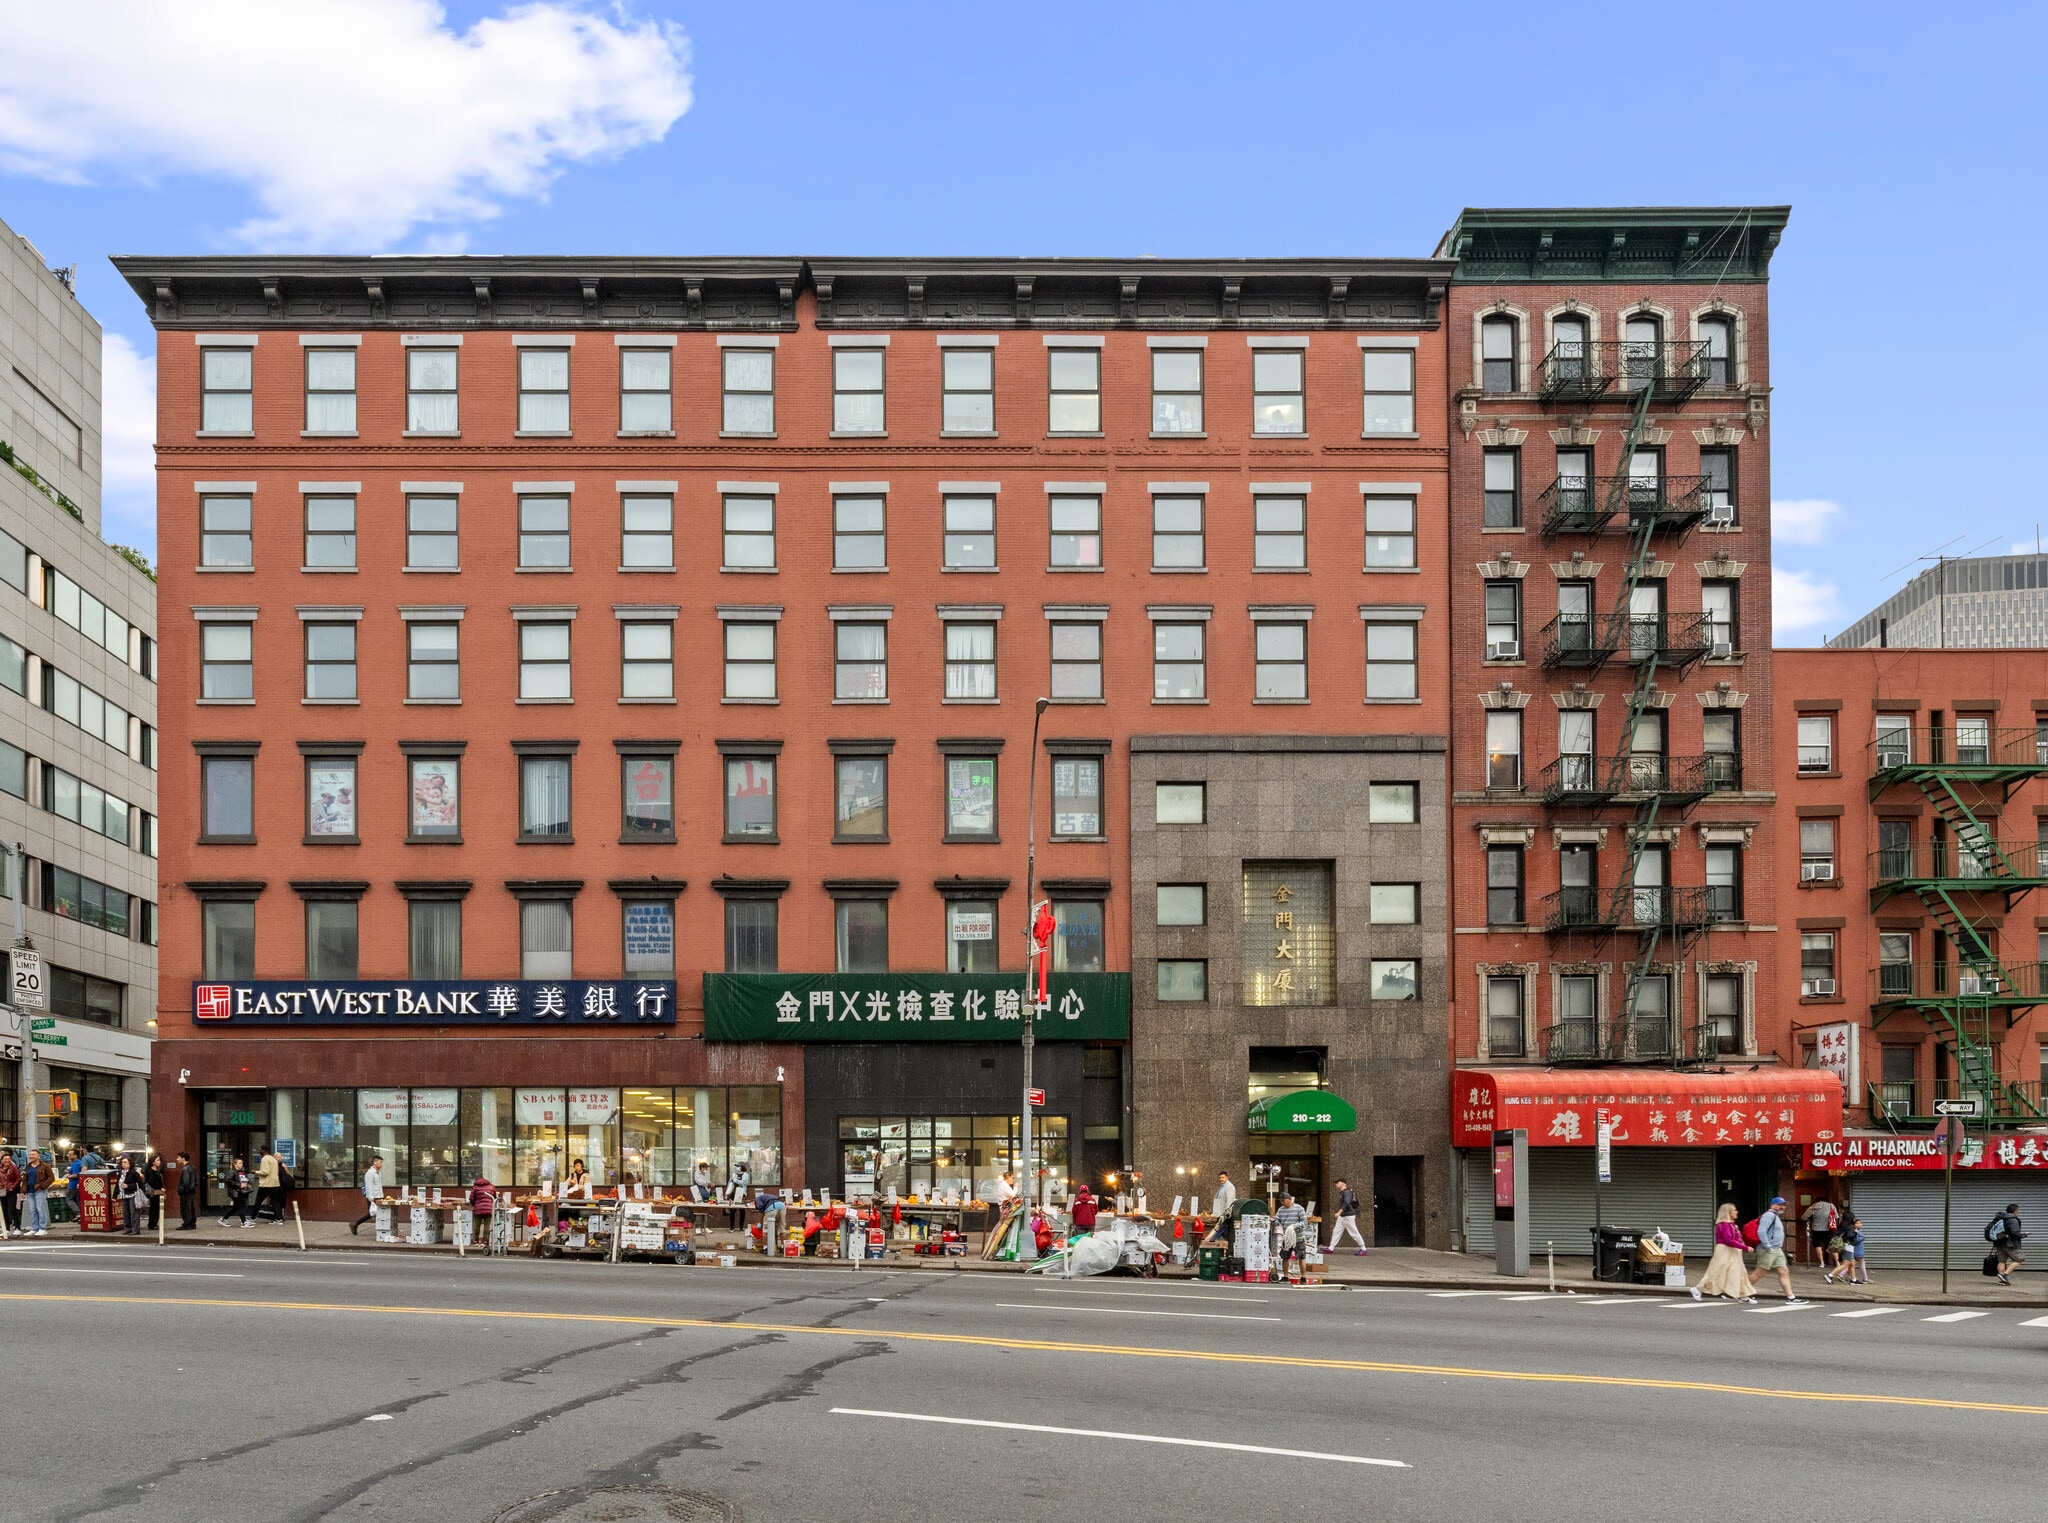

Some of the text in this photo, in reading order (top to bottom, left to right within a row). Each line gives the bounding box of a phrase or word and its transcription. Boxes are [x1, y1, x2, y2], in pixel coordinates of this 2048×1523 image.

[736, 762, 768, 800] 山
[1059, 813, 1096, 833] 古董
[979, 923, 991, 932] RENT
[12, 950, 39, 962] SPEED
[16, 960, 36, 971] LIMIT
[15, 972, 40, 990] 20
[16, 997, 42, 1006] ENFORCED
[394, 988, 482, 1015] BANK
[486, 984, 669, 1019] 華美銀行
[32, 1019, 50, 1027] CANAL
[1520, 1096, 1532, 1105] KEE
[230, 1111, 256, 1125] 208
[1814, 1141, 1843, 1156] BAC
[1847, 1140, 1862, 1156] AI
[1868, 1140, 1942, 1156] PHARMAC
[1844, 1158, 1895, 1167] PHARMACO
[1896, 1158, 1914, 1167] INC.
[84, 1206, 106, 1217] LOVE
